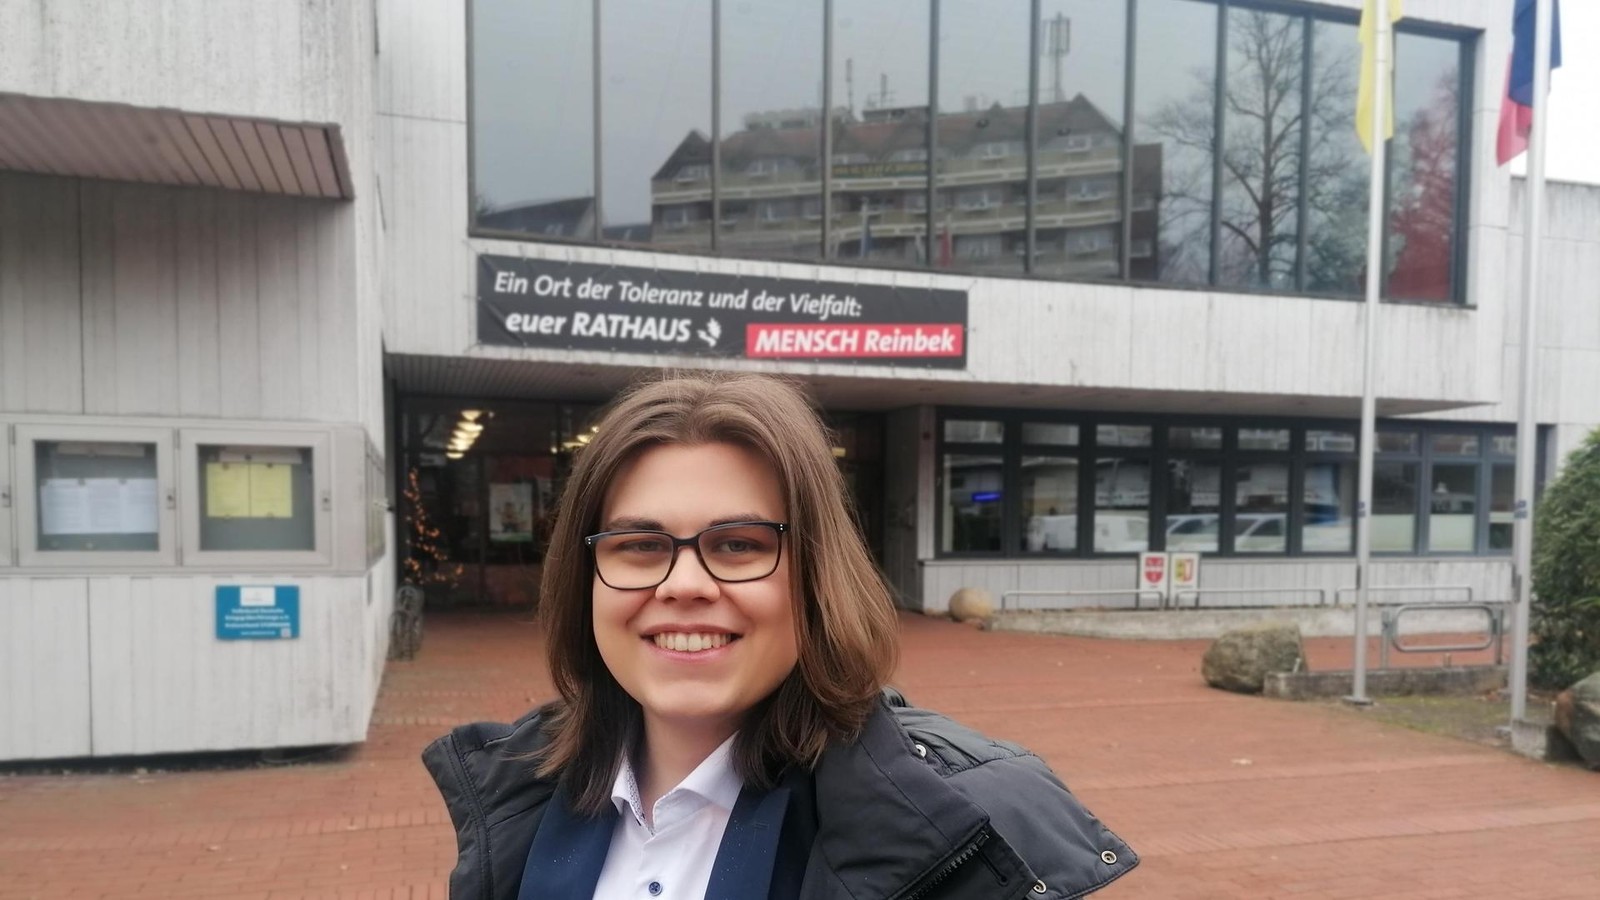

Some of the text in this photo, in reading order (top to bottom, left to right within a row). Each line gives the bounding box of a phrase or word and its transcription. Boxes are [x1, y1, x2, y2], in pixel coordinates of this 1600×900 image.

[494, 271, 863, 320] Ein Ort der Toleranz und der Vielfalt:
[505, 312, 692, 342] euer RATHAUS
[755, 327, 956, 353] MENSCH Reinbek
